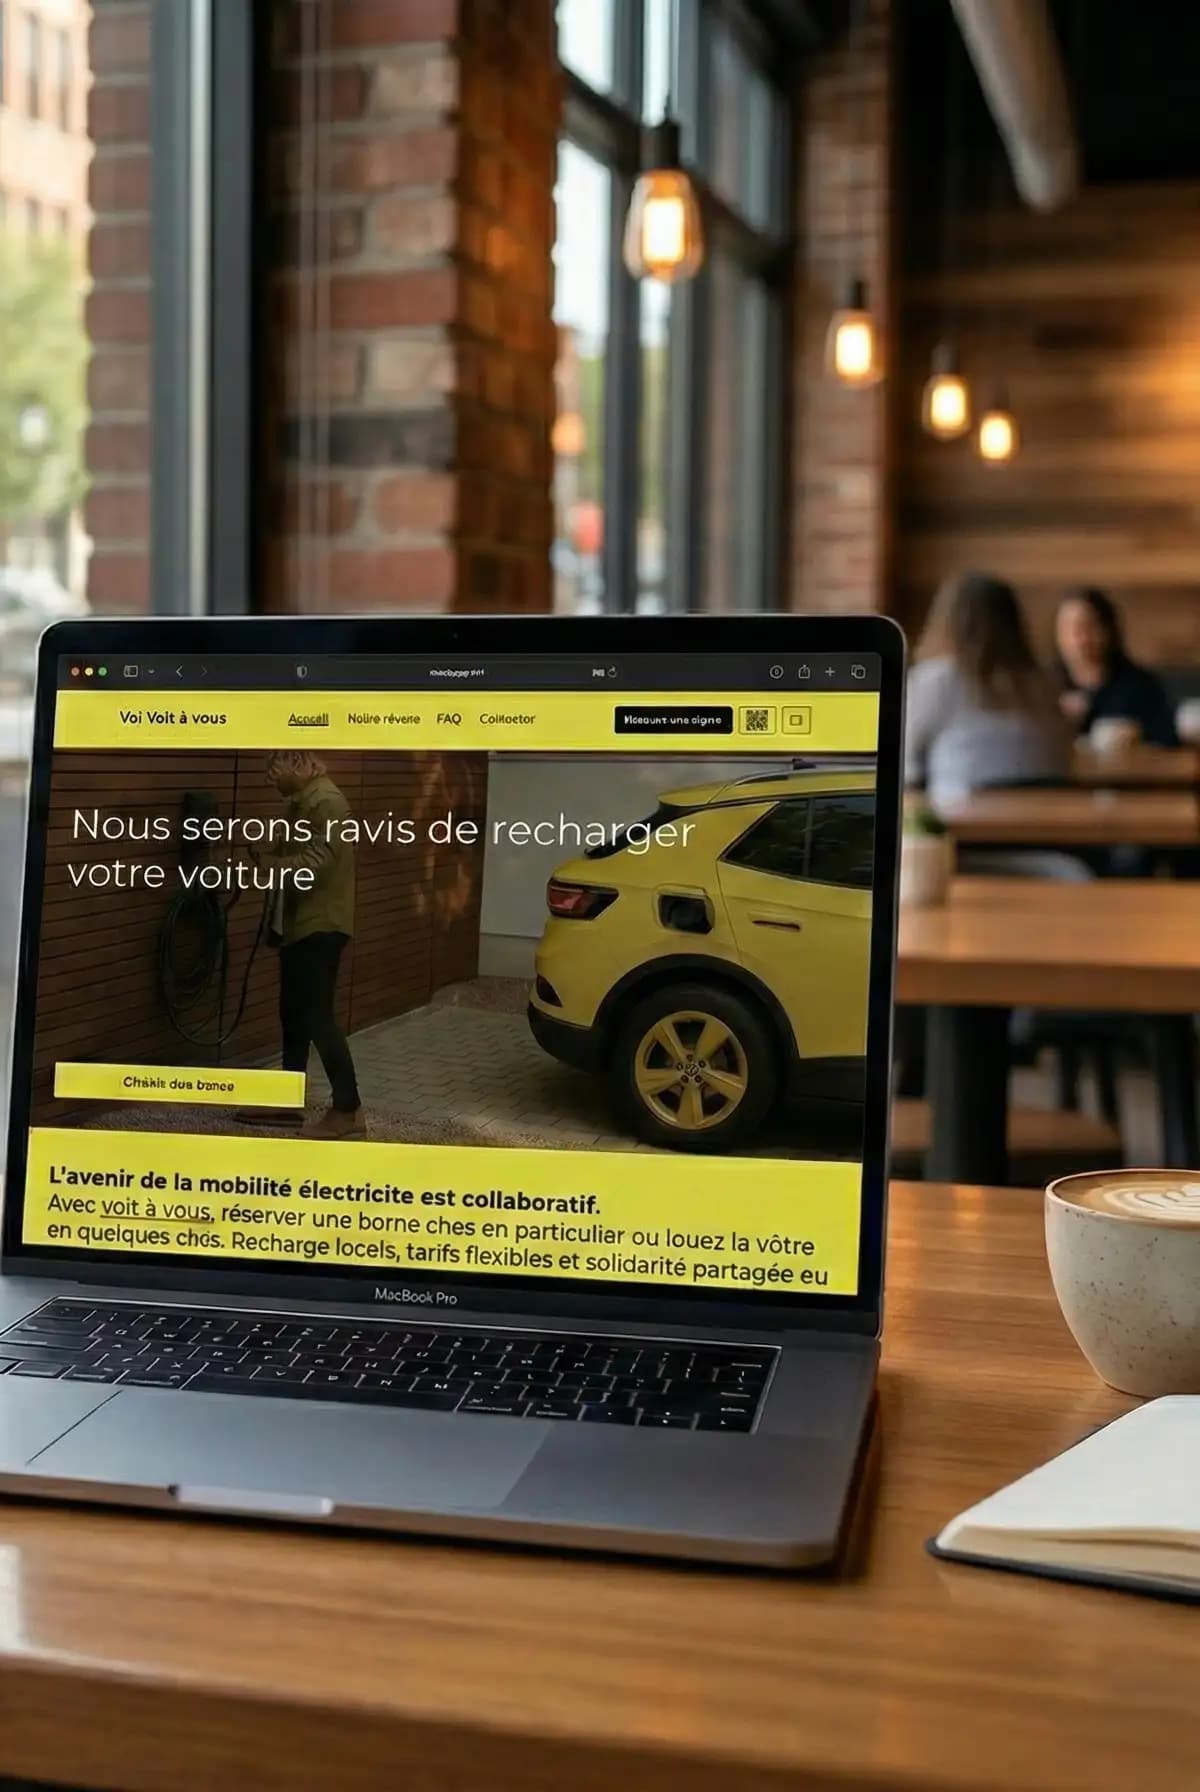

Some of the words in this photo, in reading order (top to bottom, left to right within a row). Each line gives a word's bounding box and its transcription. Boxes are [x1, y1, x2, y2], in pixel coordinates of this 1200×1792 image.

[179, 710, 187, 724] à
[192, 713, 227, 724] vous
[436, 712, 462, 726] FAQ
[72, 809, 171, 841] Nous
[182, 816, 313, 843] serons
[325, 812, 416, 844] ravis
[428, 811, 479, 845] de
[493, 812, 697, 855] recharger
[67, 860, 166, 889] votre
[178, 858, 316, 892] voiture
[49, 1166, 135, 1188] L'avenir
[140, 1171, 167, 1190] de
[174, 1173, 193, 1192] la
[199, 1176, 292, 1198] mobilité
[299, 1179, 414, 1205] électricite
[421, 1189, 456, 1207] est
[462, 1190, 600, 1214] collaboratif.
[47, 1193, 96, 1214] Avec
[101, 1197, 140, 1217] voit
[145, 1197, 157, 1217] à
[163, 1205, 216, 1223] vous,
[221, 1203, 306, 1226] réserver
[312, 1213, 352, 1228] une
[359, 1211, 421, 1233] borne
[426, 1216, 476, 1236] ches
[482, 1223, 508, 1238] en
[632, 1231, 659, 1247] ou
[666, 1228, 725, 1250] louez
[732, 1232, 750, 1252] la
[756, 1234, 815, 1256] vôtre
[47, 1224, 71, 1239] en
[77, 1225, 170, 1248] quelques
[232, 1232, 330, 1258] Recharge
[406, 1243, 460, 1263] tarifs
[465, 1245, 553, 1268] flexibles
[558, 1253, 580, 1270] et
[586, 1253, 687, 1277] solidarité
[693, 1263, 794, 1286] partagée
[800, 1269, 828, 1285] eu
[374, 1287, 434, 1304] MacBook
